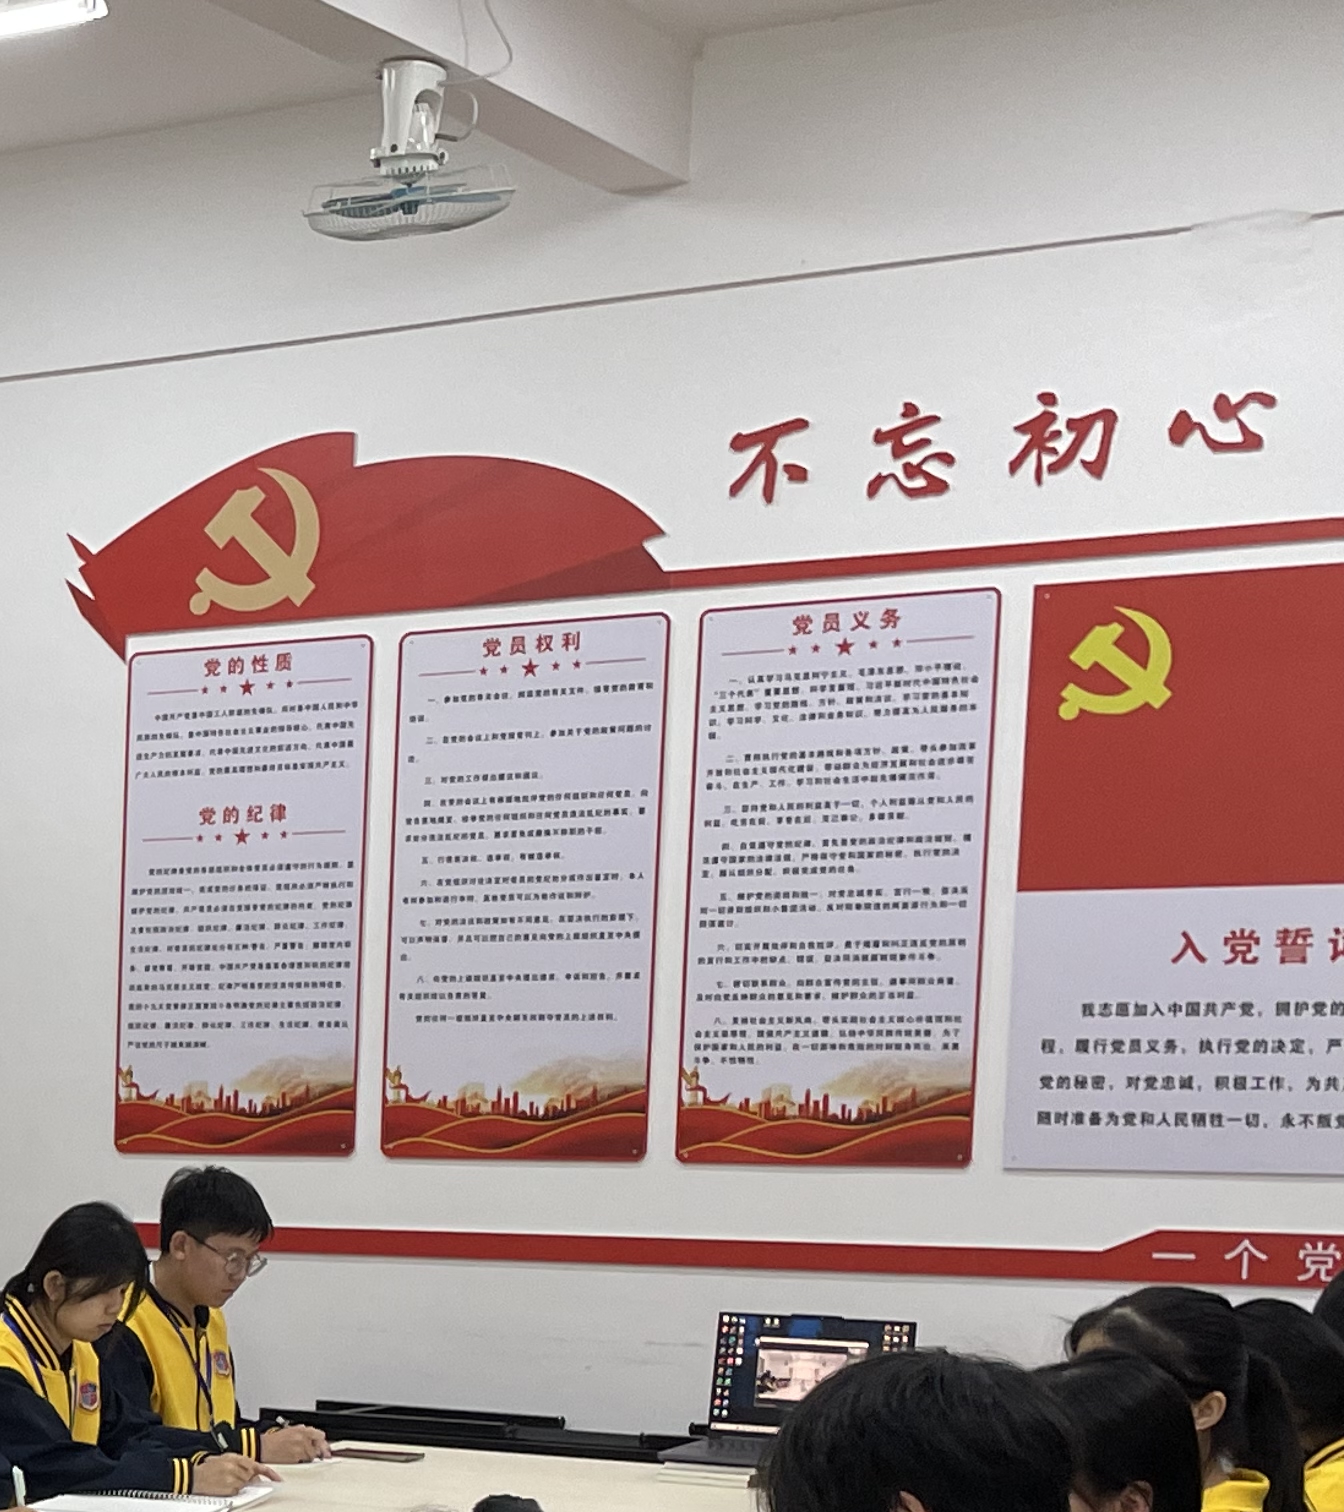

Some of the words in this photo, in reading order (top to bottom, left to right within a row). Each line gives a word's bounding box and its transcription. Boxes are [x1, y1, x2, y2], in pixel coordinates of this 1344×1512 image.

[728, 391, 1278, 506] 不忘初心
[793, 608, 902, 636] 党员义务
[482, 631, 582, 658] 党员权利
[204, 652, 294, 678] 党的性质
[199, 803, 288, 826] 党的纪律
[1038, 1075, 1344, 1092] 党的秘密，对党忠诚，积极工作，为共
[1151, 1238, 1341, 1282] 一个党
